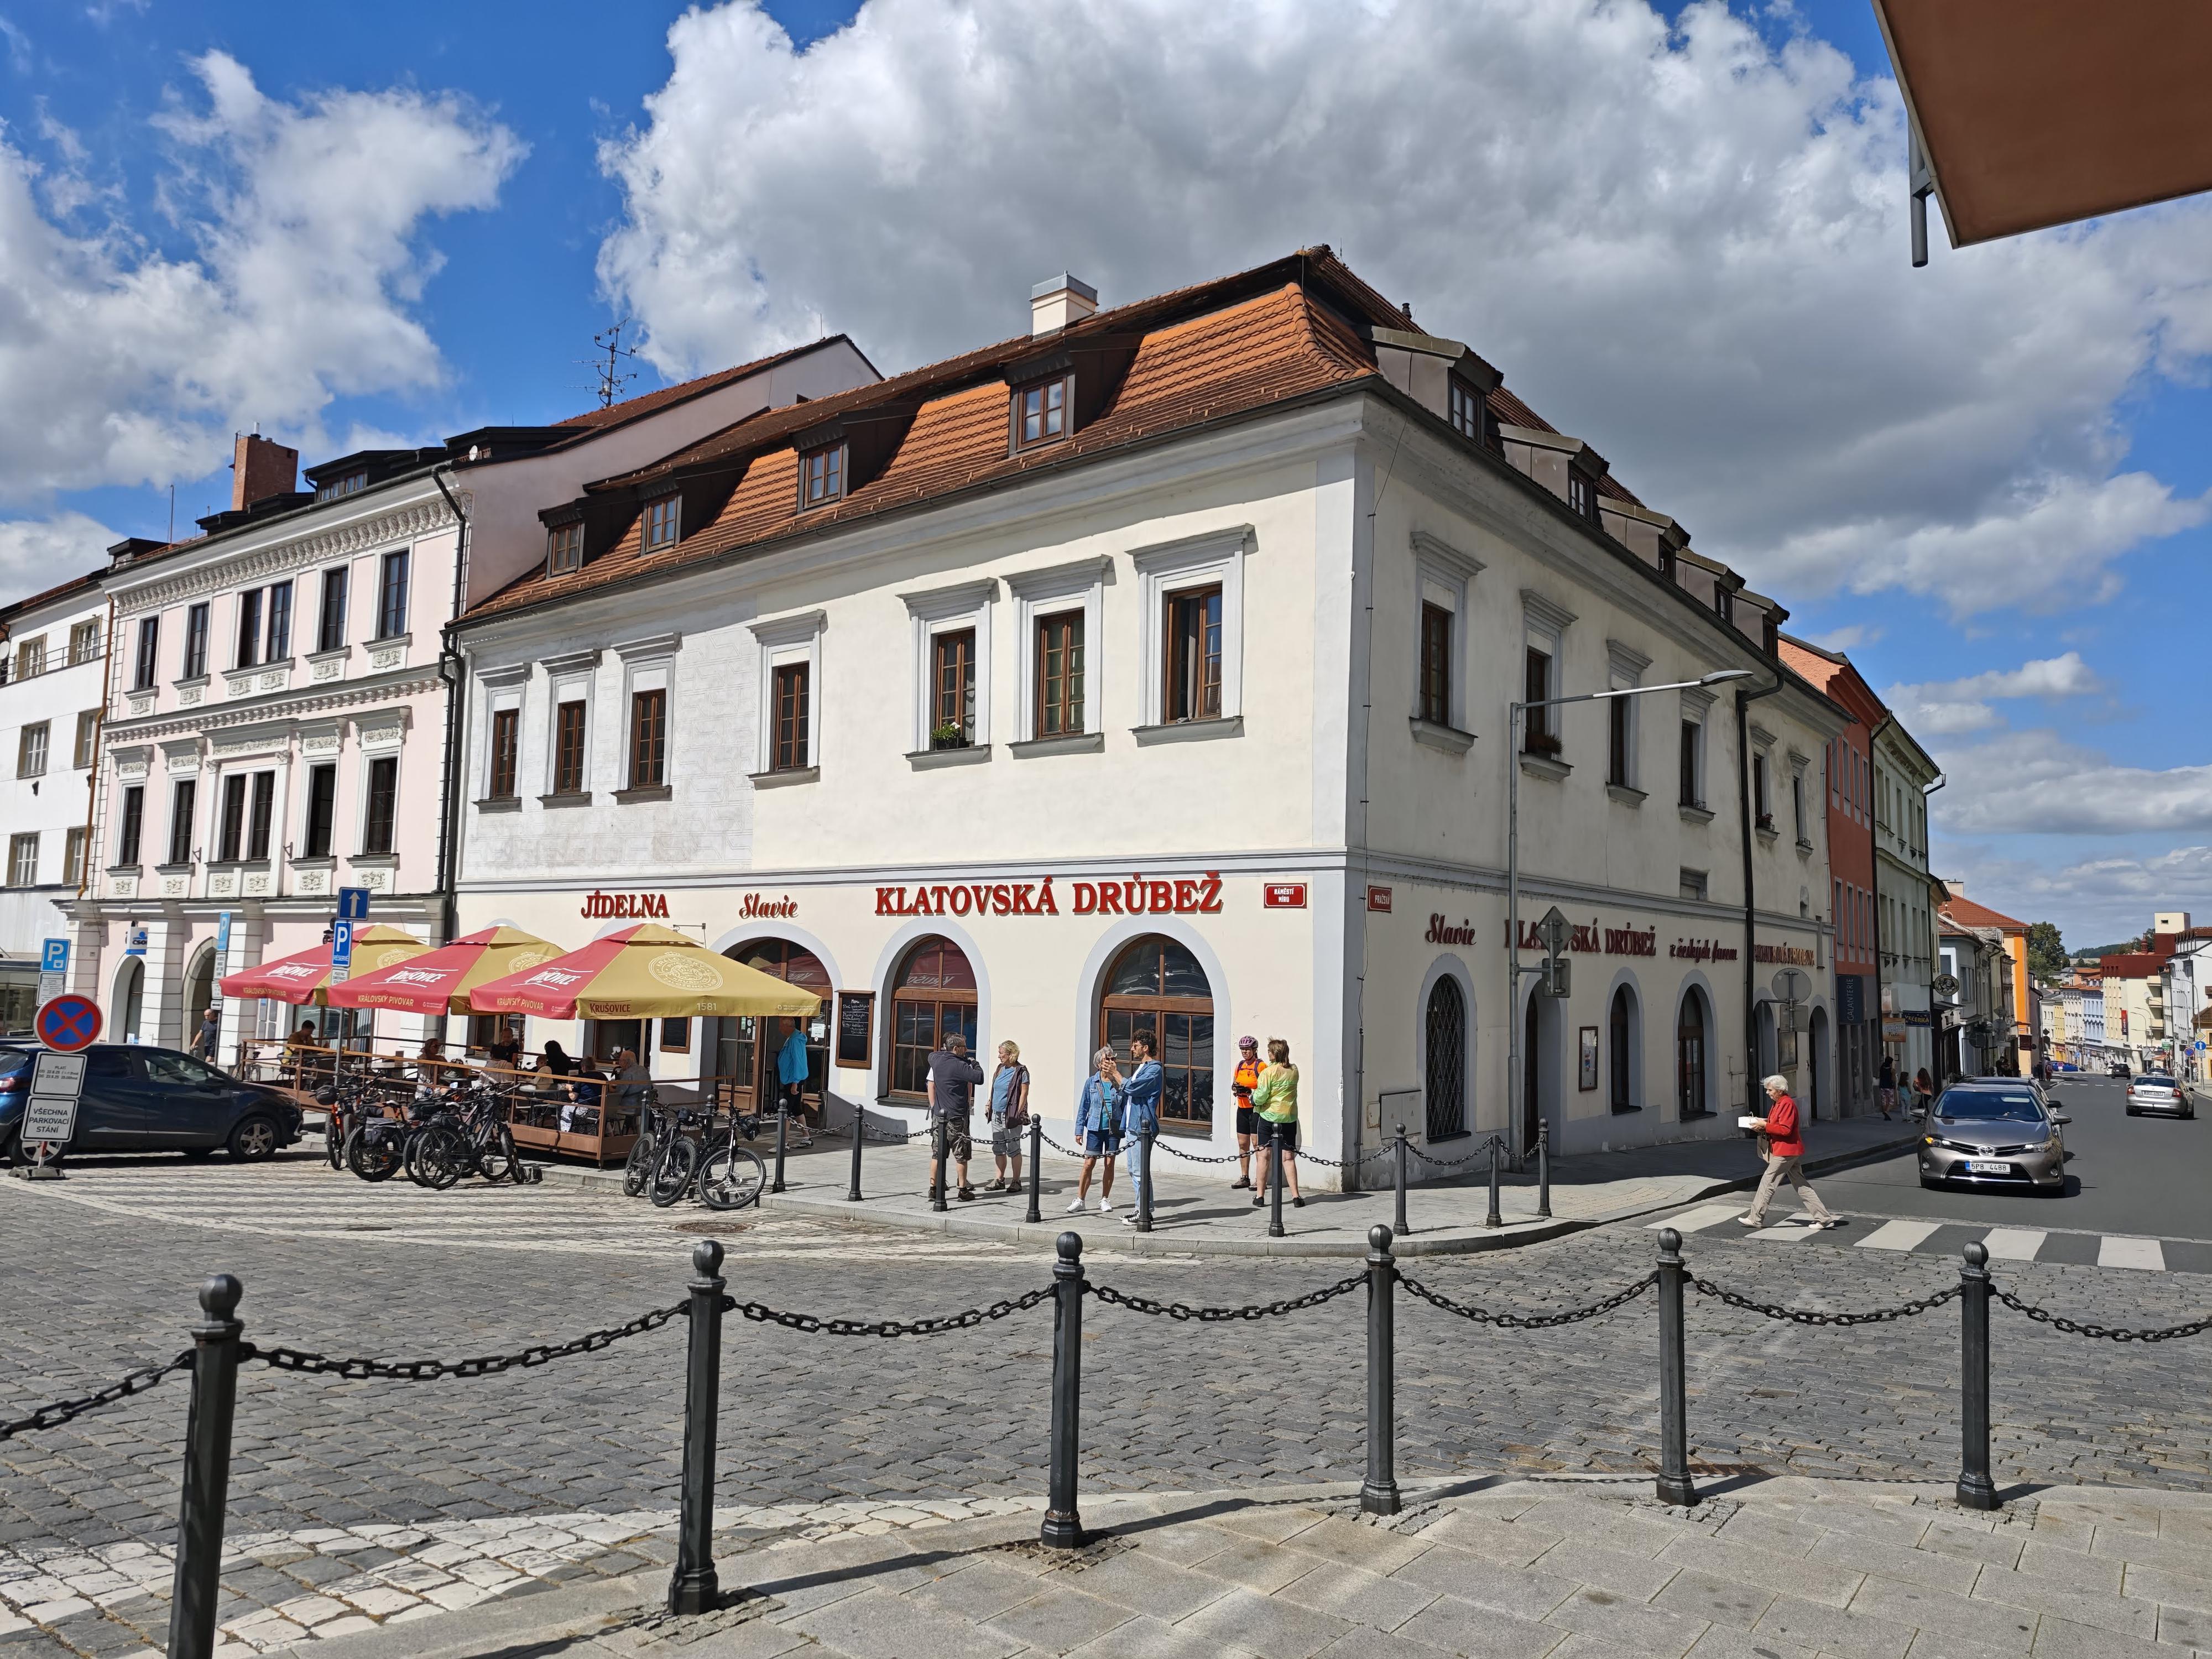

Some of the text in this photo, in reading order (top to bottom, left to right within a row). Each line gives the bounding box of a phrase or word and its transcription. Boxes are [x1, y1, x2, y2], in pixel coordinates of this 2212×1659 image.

[875, 870, 1223, 916] KLATOVSKÁ DRŮBEŽ
[1375, 894, 1390, 905] PRAŽSKÁ
[581, 889, 670, 919] JÍDELNA
[739, 893, 799, 919] Slavie
[336, 926, 348, 952] P
[1425, 912, 1477, 945] Slavie
[1605, 922, 1657, 956] DRŮBEŽ
[48, 942, 64, 961] P
[1712, 940, 1738, 963] farem
[358, 994, 388, 1003] KRÁLOVSKÝ
[389, 996, 414, 1006] PIVOVAR
[520, 999, 544, 1011] PIVOVAR
[589, 1003, 631, 1015] KRUŠOVICE
[696, 1003, 717, 1011] 1581
[34, 1107, 68, 1115] VŠECHNA
